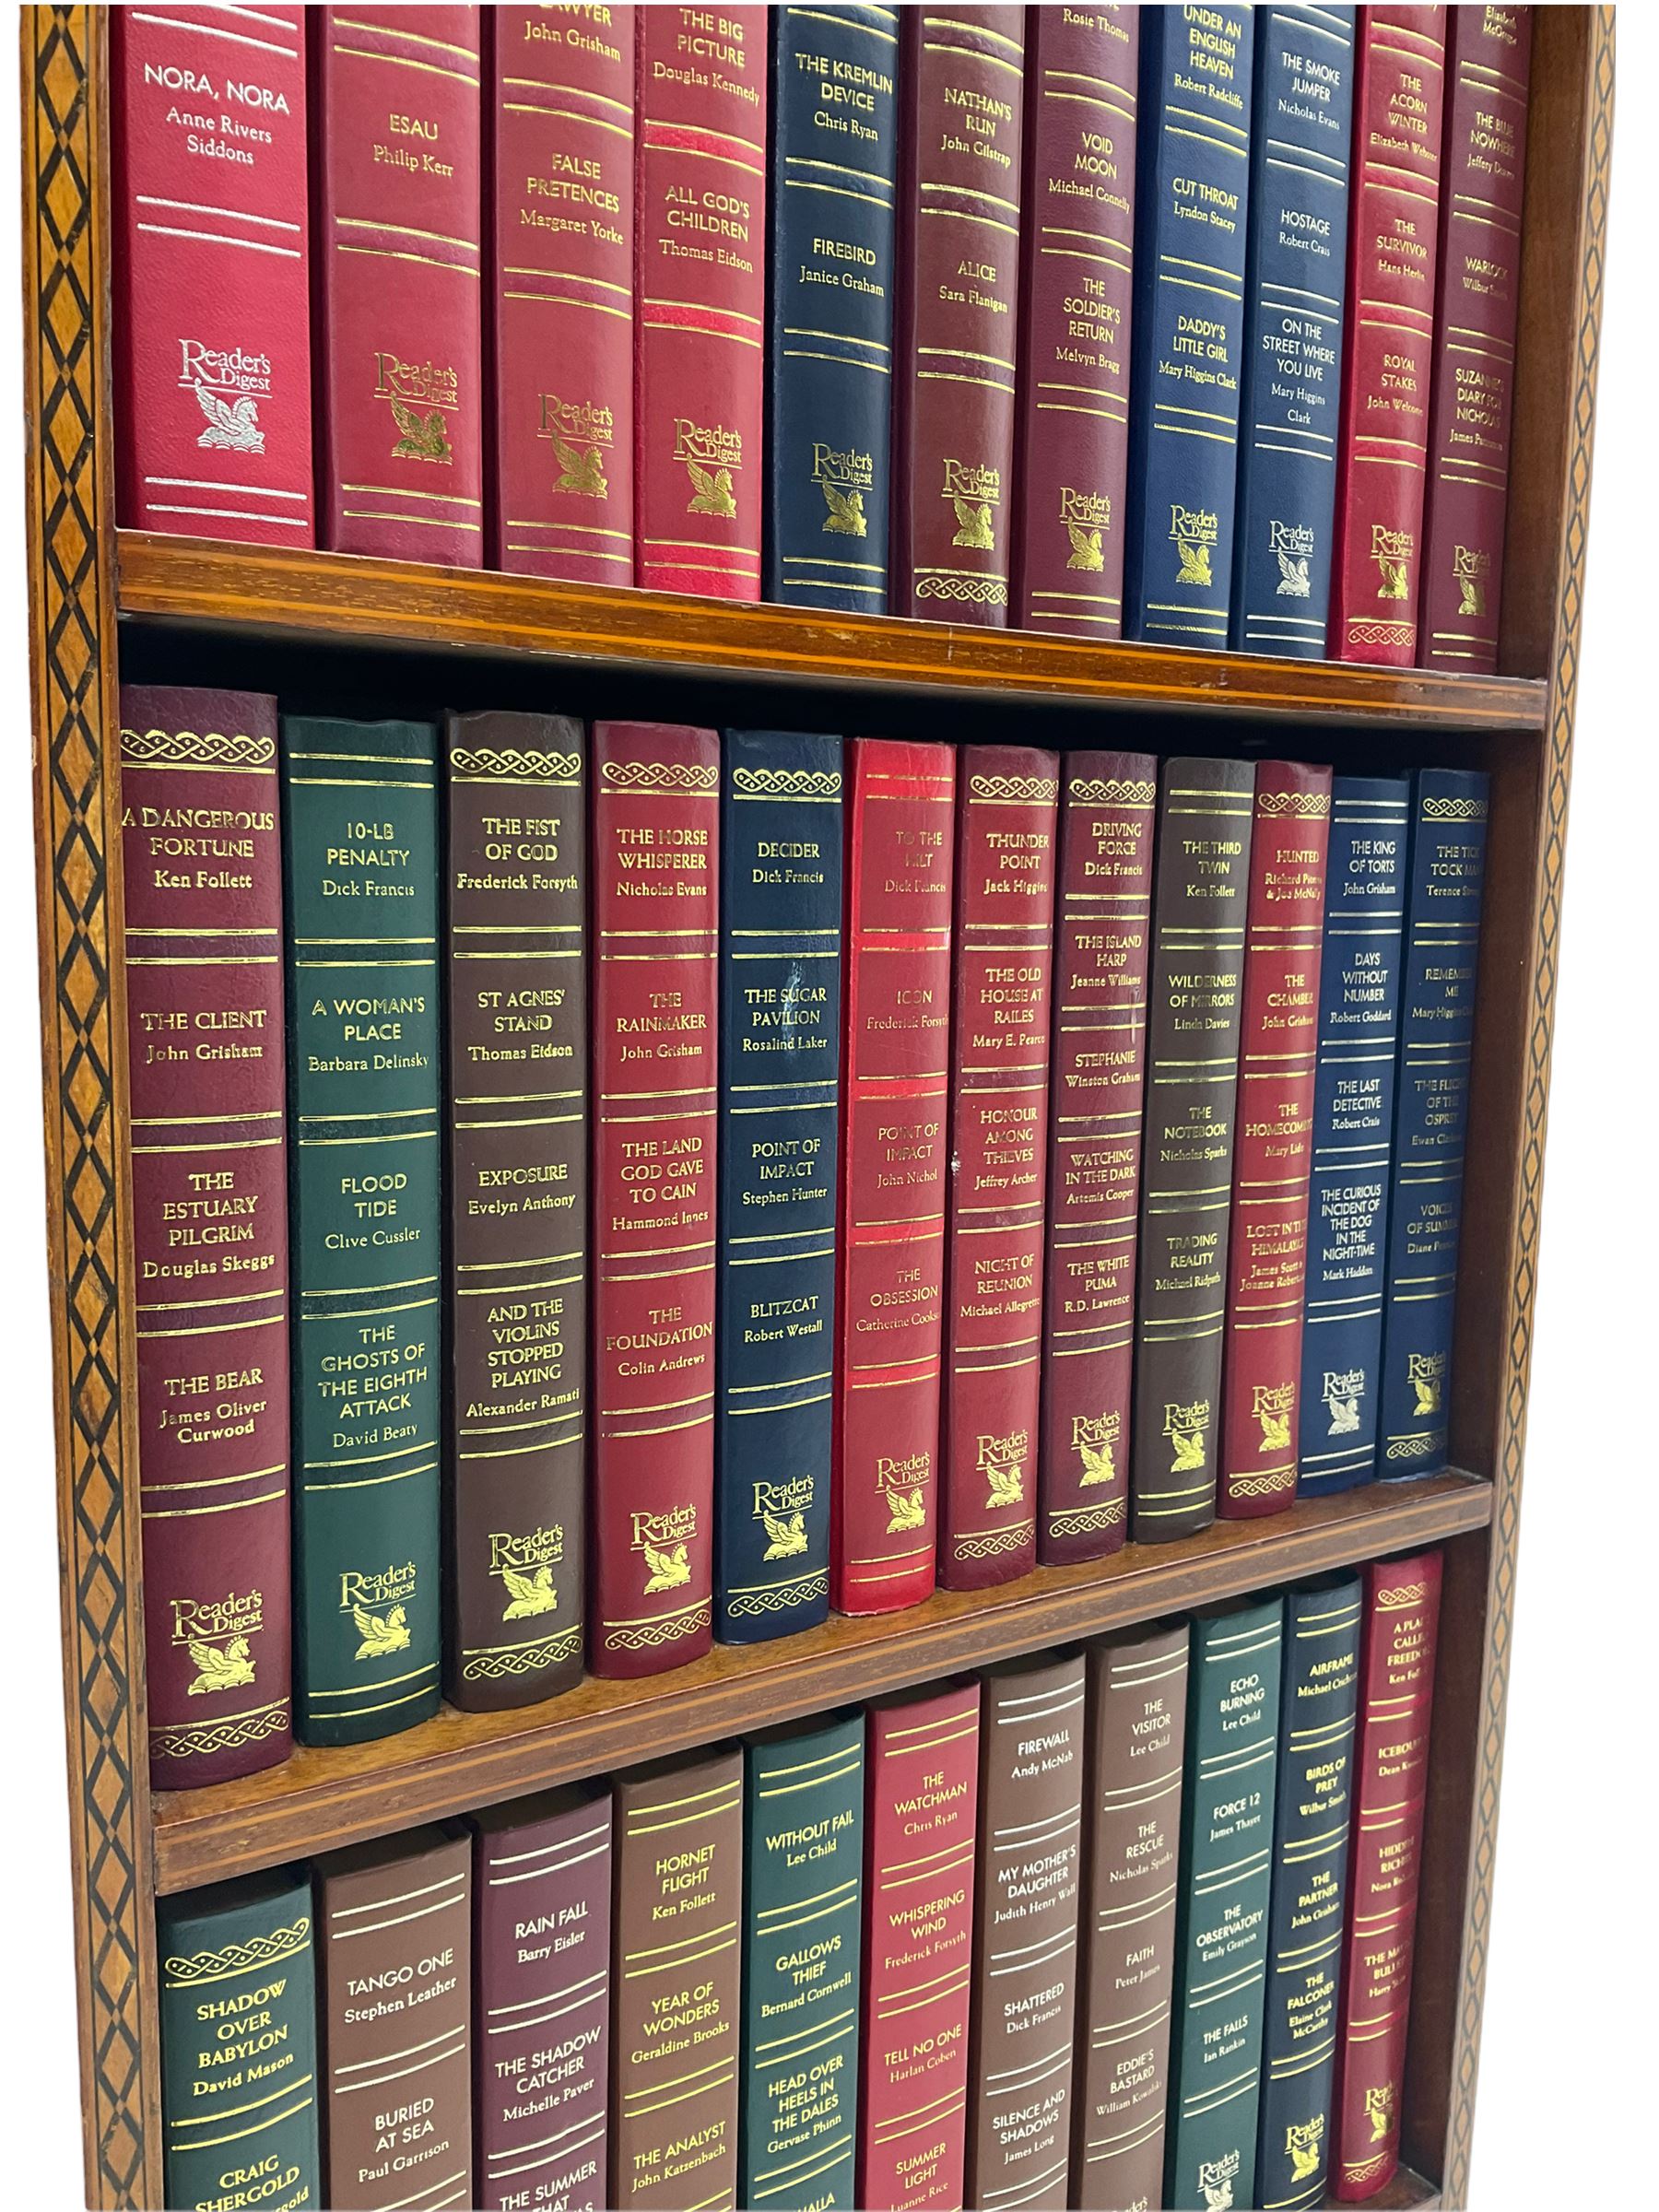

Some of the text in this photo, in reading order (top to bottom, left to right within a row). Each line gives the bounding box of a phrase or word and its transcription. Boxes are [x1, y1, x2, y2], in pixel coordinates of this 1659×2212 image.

[679, 8, 743, 41] THE BIG
[524, 21, 620, 62] John Grisham
[678, 34, 745, 68] PICTURE
[653, 62, 759, 107] Douglas Kennedy
[795, 53, 892, 94] THE KREMLIN
[145, 63, 289, 114] NORA, NORA
[821, 83, 874, 111] DEVICE
[945, 88, 1011, 121] NATHAN'S
[166, 107, 272, 143] Anne Rivers
[390, 114, 438, 140] ESAU
[815, 112, 878, 141] Chris Ryan
[966, 114, 995, 136] RUN
[187, 135, 254, 164] Siddons
[941, 135, 1010, 169] John Gilstrap
[1082, 132, 1112, 154] VOID
[374, 145, 453, 177] Philip Kerr
[553, 154, 600, 179] FALSE
[1075, 154, 1116, 179] MOON
[527, 177, 619, 213] PRETENCES
[665, 186, 749, 219] ALL GOD'S
[1173, 178, 1238, 210] CUT THROAT
[521, 209, 623, 244] Margaret Yorke
[668, 209, 749, 241] CHILDREN
[1279, 209, 1330, 236] HOSTAGE
[814, 239, 876, 265] FIREBIRD
[1279, 232, 1330, 256] Robert Crais
[662, 240, 752, 273] Thomas Eidson
[799, 265, 884, 297] Janice Graham
[958, 261, 995, 282] ALICE
[940, 286, 1007, 312] Sara Flanigan
[1179, 316, 1225, 340] DADDY'S
[179, 339, 270, 382] Reader's
[1173, 336, 1228, 362] LITTLE GIRL
[1383, 355, 1416, 371] ROYAL
[220, 369, 271, 391] Digest
[1382, 373, 1417, 391] STAKES
[348, 823, 394, 840] 10-LB
[482, 818, 560, 836] THE FIST
[617, 829, 707, 845] THE HORSE
[486, 843, 557, 861] OF GOD
[759, 842, 819, 857] DECIDER
[986, 833, 1049, 848] THUNDER
[1182, 841, 1241, 854] THE THIRD
[1351, 841, 1395, 854] THE KING
[328, 849, 409, 865] PENALTY
[618, 853, 707, 868] WHISPERER
[1000, 855, 1041, 868] POINT
[1198, 861, 1230, 874] TWIN
[1349, 859, 1394, 873] OF TORTS
[154, 870, 252, 888] Ken Follett
[323, 880, 414, 896] Dick Francis
[457, 874, 578, 892] Frederick Forsyth
[753, 869, 823, 883] Dick Francis
[617, 882, 706, 896] Nicholas Evans
[1187, 885, 1235, 897] Ken Follett
[1343, 883, 1395, 896] John Grisham
[141, 1010, 266, 1030] THE CLIENT
[1076, 1051, 1135, 1067] STEPHANIE
[1065, 1073, 1140, 1087] Winston Graham
[479, 1164, 567, 1186] EXPOSURE
[877, 1169, 937, 1188] John Nichol
[974, 1172, 1037, 1190] Jeffrey Archer
[469, 1194, 575, 1216] Evelyn Anthony
[325, 1228, 420, 1249] Clive Cussler
[1067, 1255, 1129, 1276] THE WHITE
[870, 1285, 937, 1306] OBSESSION
[1086, 1277, 1116, 1291] PUMA
[649, 1307, 681, 1324] THE
[751, 1296, 818, 1318] BLITZCAT
[1065, 1295, 1130, 1312] R.D. Lawrence
[607, 1322, 712, 1350] FOUNDATION
[745, 1320, 822, 1342] Robert Westall
[618, 1351, 704, 1375] Colin Andrews
[164, 1369, 263, 1395] THE BEAR
[1230, 1674, 1258, 1695] ECHO
[1145, 1699, 1162, 1714] THE
[1220, 1688, 1265, 1712] BURNING
[1132, 1713, 1171, 1735] VISITOR
[1018, 1730, 1069, 1756] FIREWALL
[1012, 1750, 1073, 1778] Andy McNab
[924, 1771, 944, 1789] THE
[1316, 1776, 1337, 1794] PREY
[895, 1782, 967, 1816] WATCHMAN
[1214, 1793, 1260, 1819] FORCE 12
[766, 1810, 853, 1851] WITHOUT FAIL
[904, 1812, 957, 1835] Chris Ryan
[656, 1844, 715, 1876] HORNET
[787, 1839, 836, 1866] Lee Child
[663, 1867, 709, 1894] FLIGHT
[1312, 1871, 1330, 1887] THE
[516, 1901, 588, 1938] RAIN FALL
[518, 1932, 584, 1963] Barry Eisler
[347, 1948, 453, 1996] TANGO ONE
[1306, 1972, 1324, 1988] THE
[197, 1979, 286, 2021] SHADOW
[345, 1976, 456, 2023] Stephen Leather
[218, 2012, 271, 2041] OVER
[199, 2025, 287, 2068] BABYLON
[194, 2054, 293, 2096] David Mason
